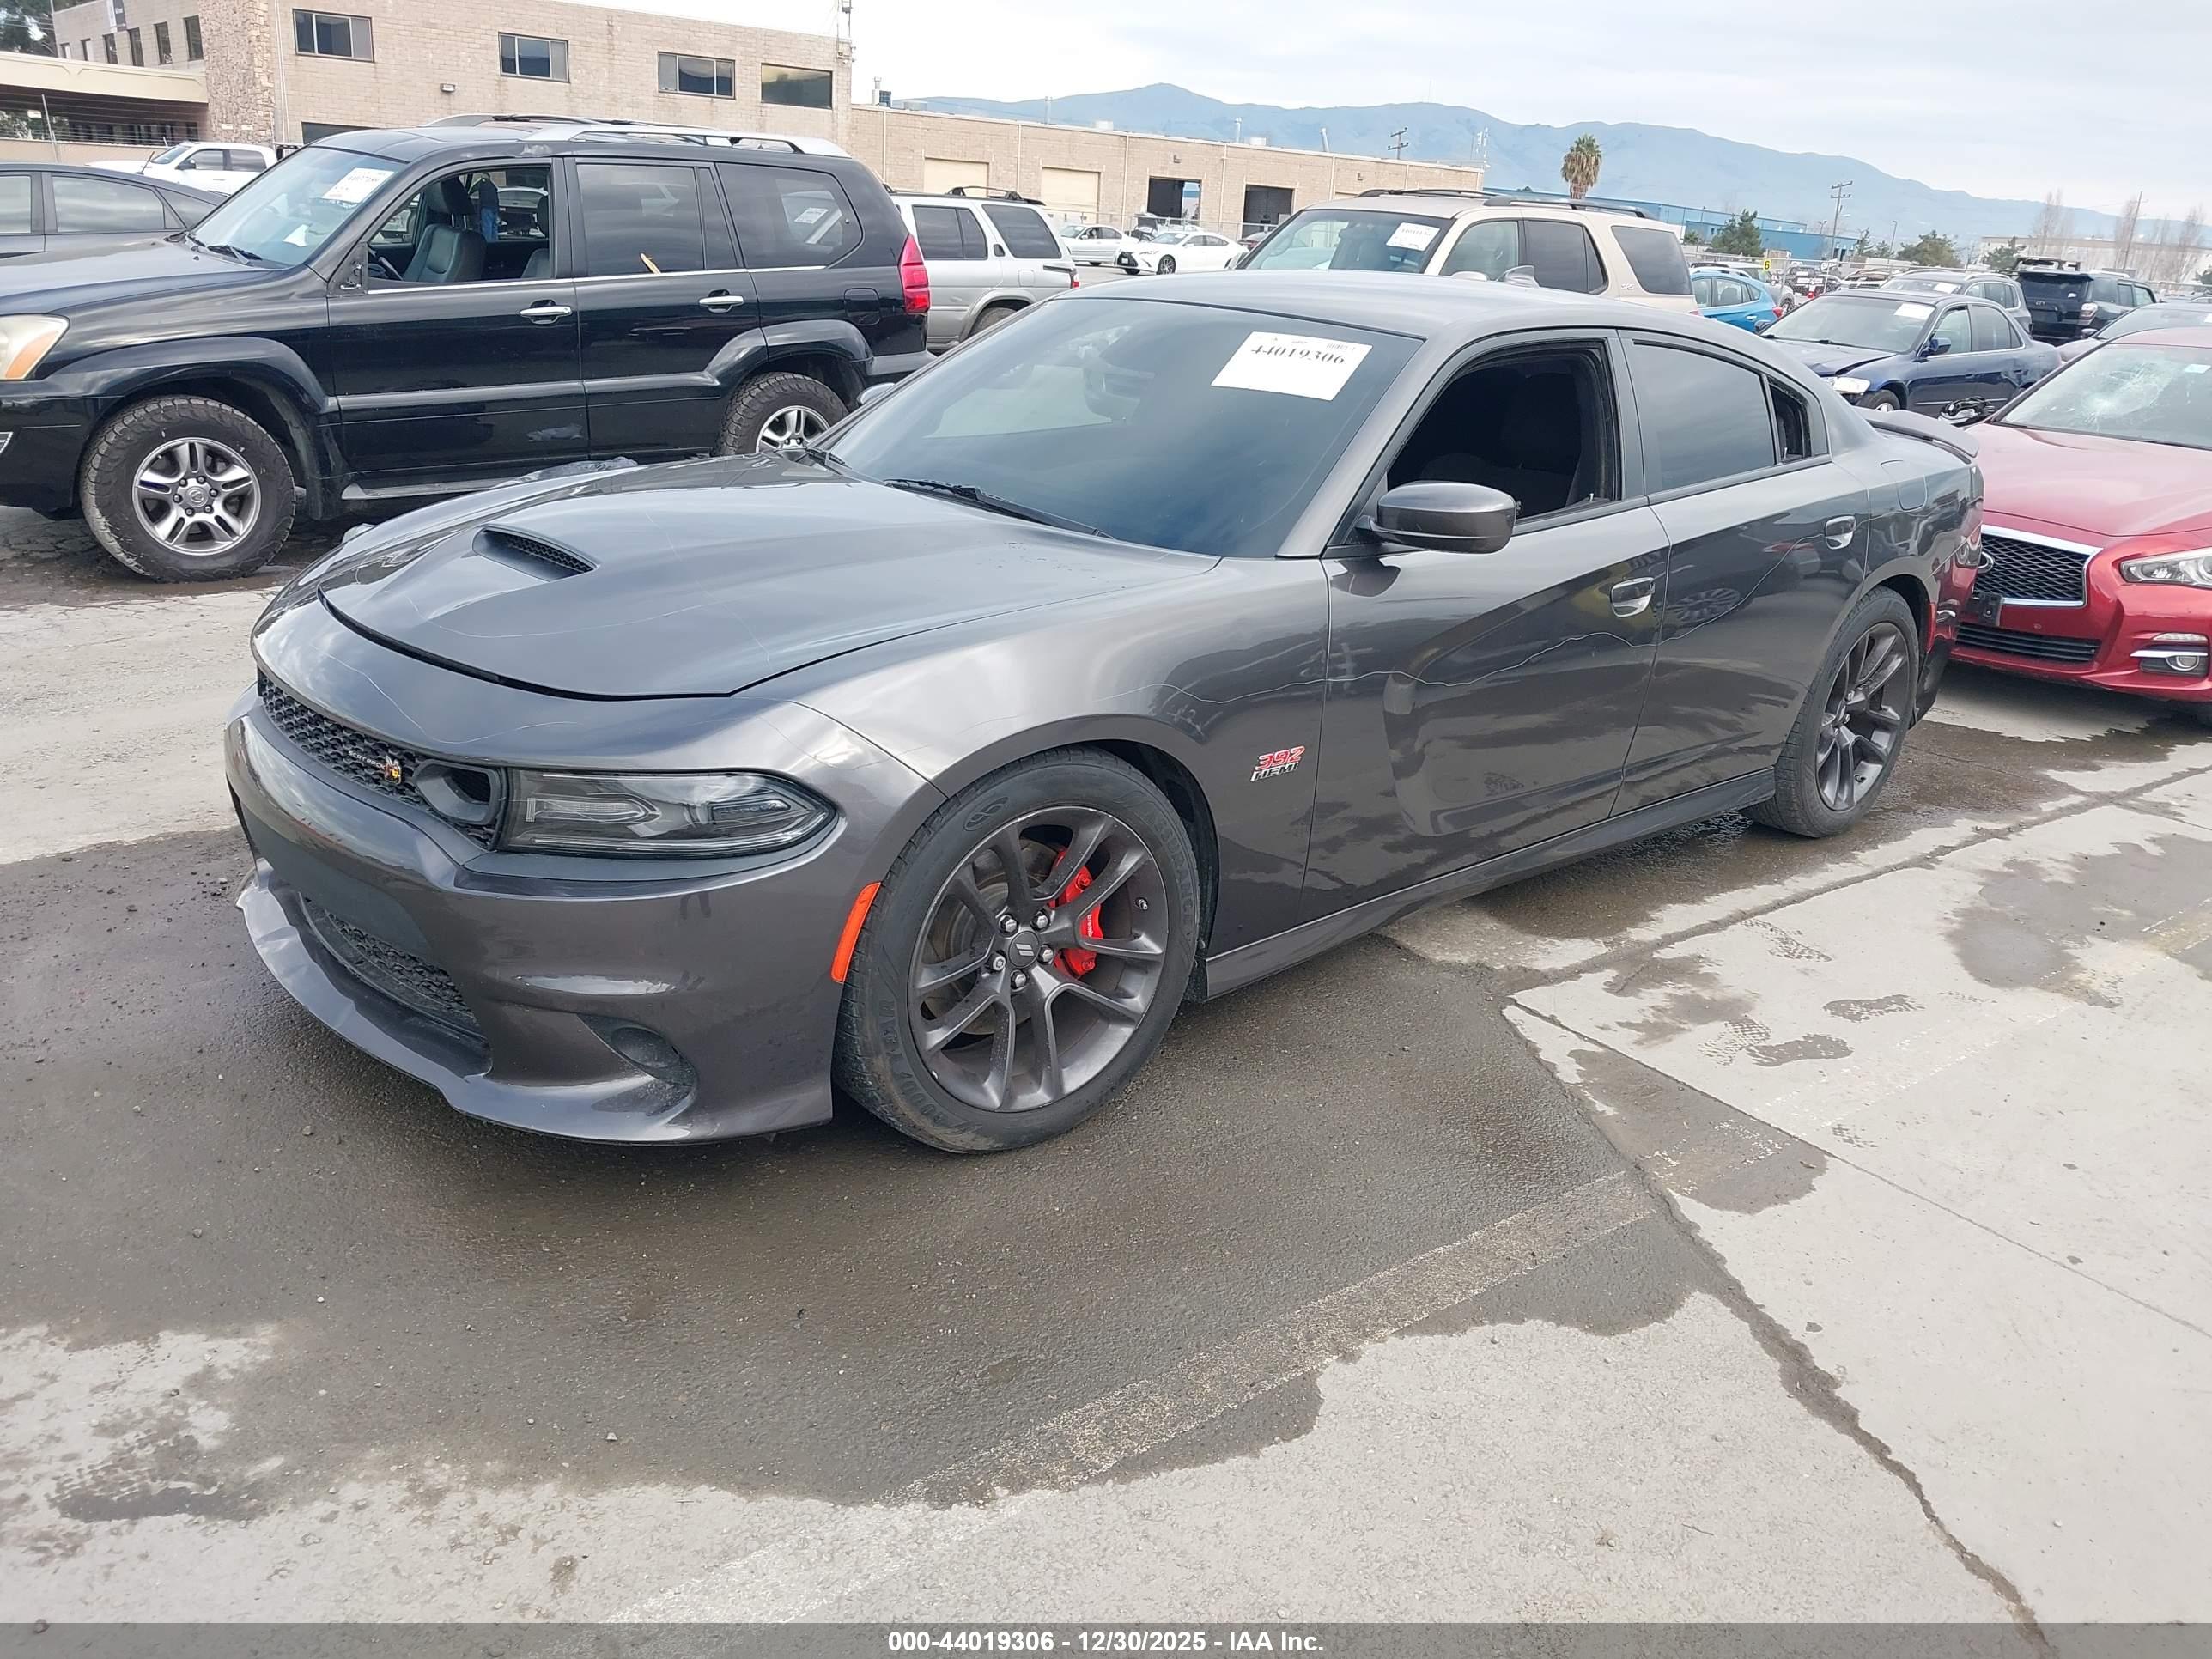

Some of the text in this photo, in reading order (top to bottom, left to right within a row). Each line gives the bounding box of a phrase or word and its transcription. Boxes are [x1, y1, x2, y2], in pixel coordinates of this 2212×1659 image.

[1251, 344, 1346, 364] 44019306
[1255, 745, 1305, 770] 392
[1250, 762, 1299, 781] HEMI
